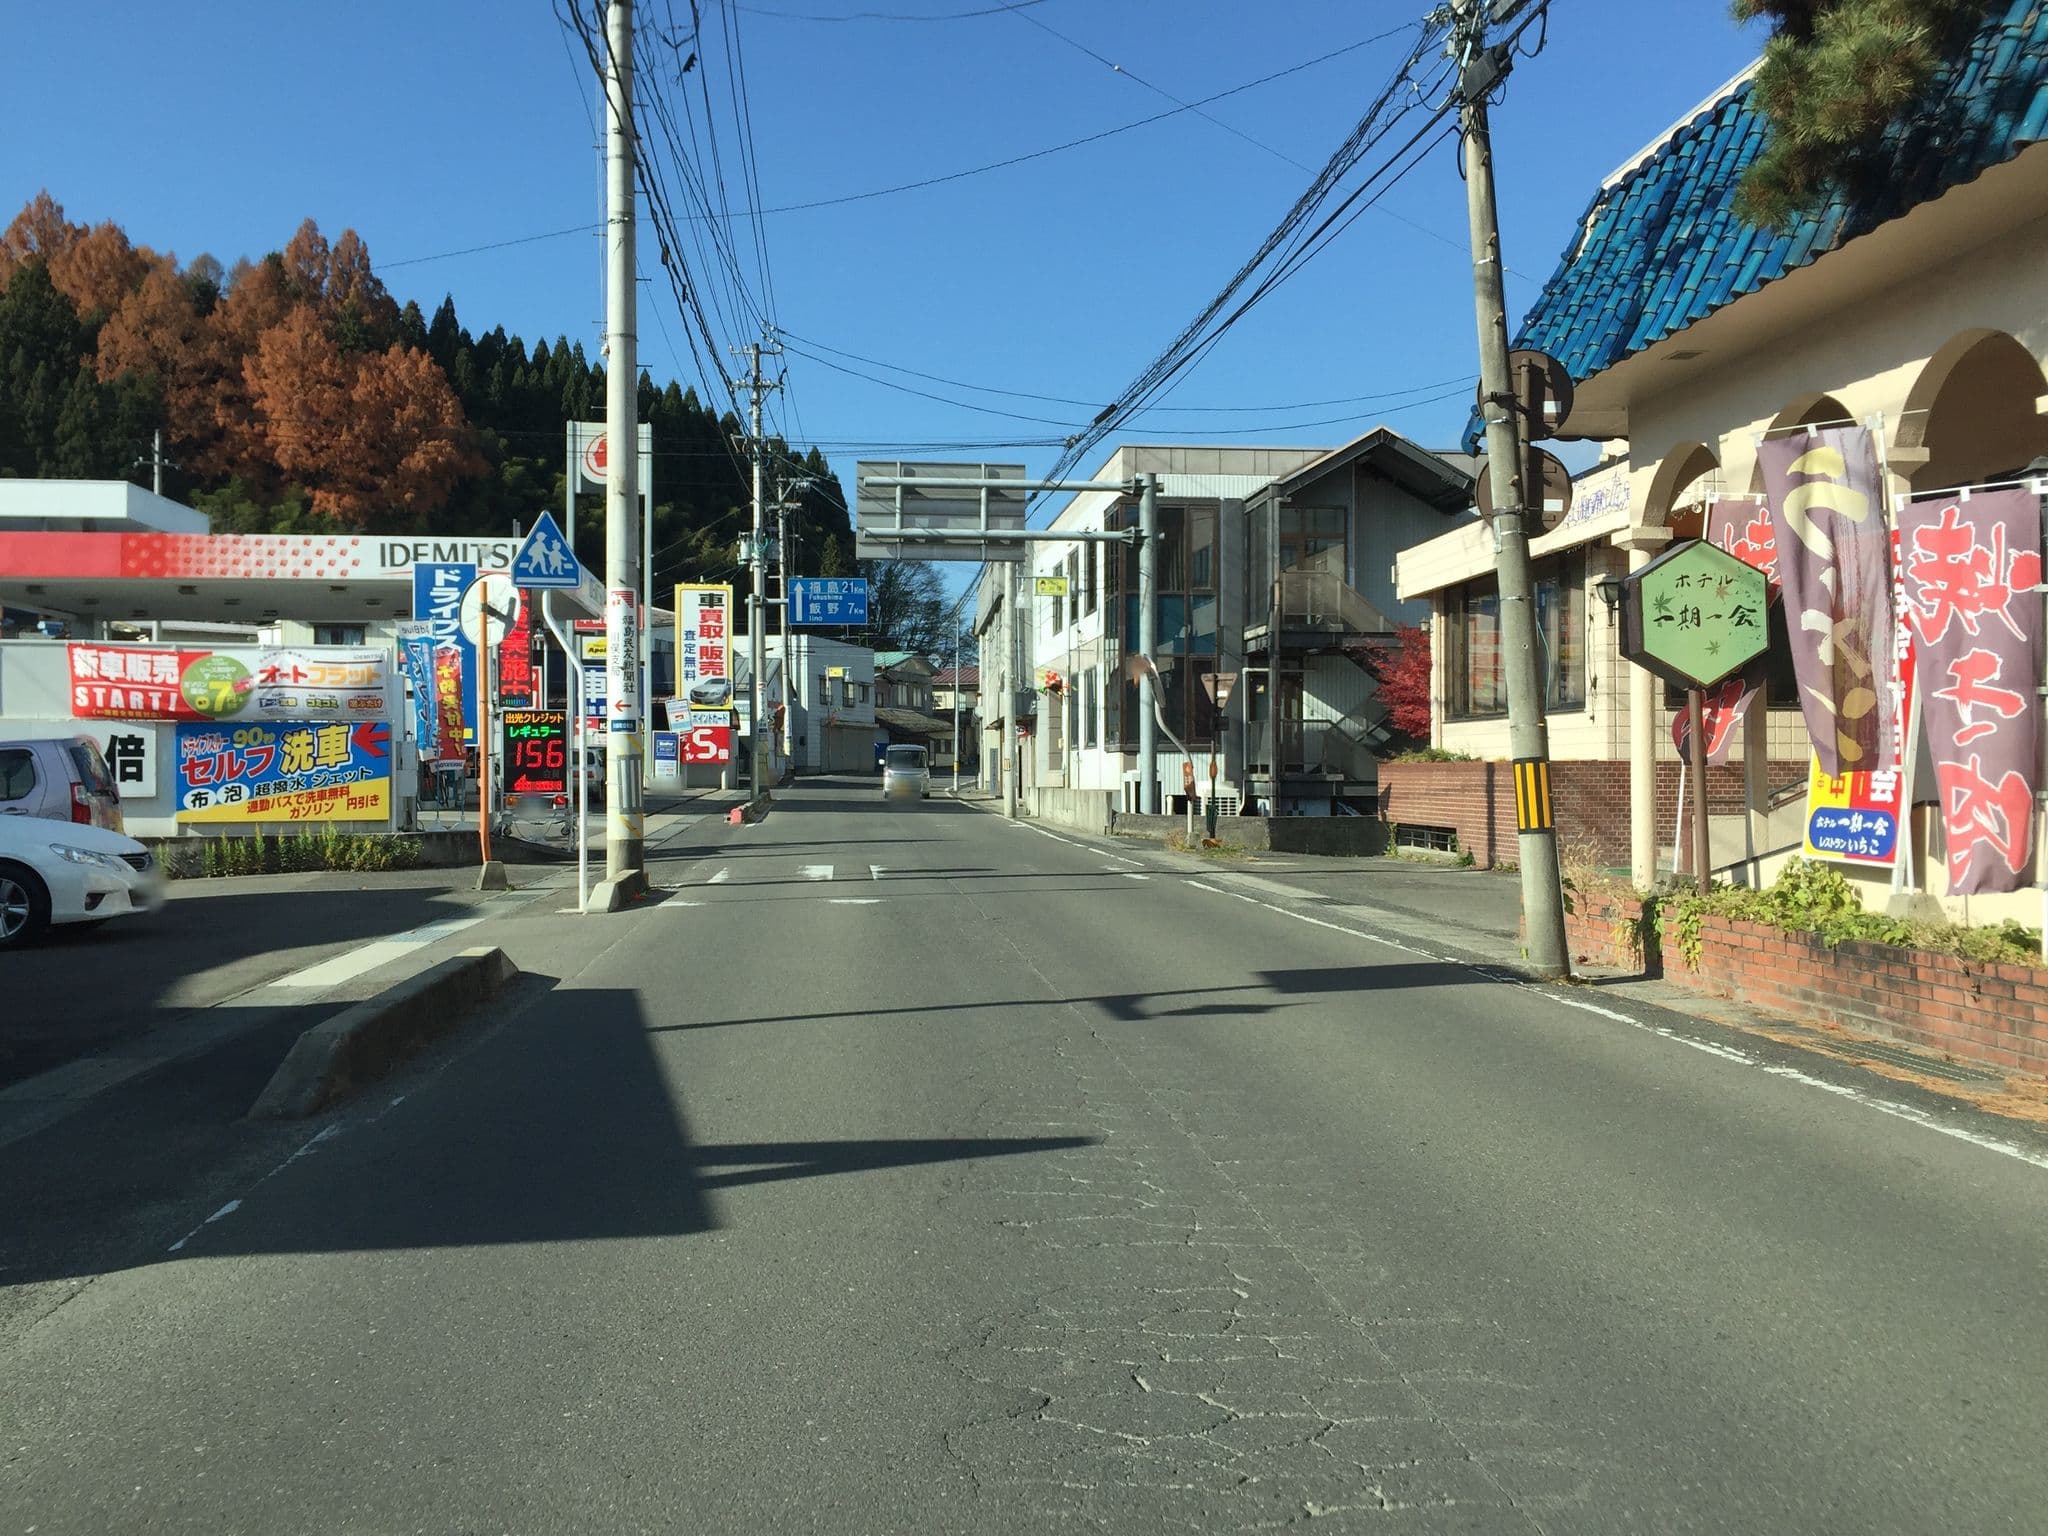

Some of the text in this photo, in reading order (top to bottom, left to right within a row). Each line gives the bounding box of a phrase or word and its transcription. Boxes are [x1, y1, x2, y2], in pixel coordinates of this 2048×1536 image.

[380, 543, 518, 568] IDEMITS
[810, 581, 838, 593] 福島
[1676, 574, 1733, 588] ホテル
[809, 603, 839, 614] 飯野
[1653, 604, 1757, 630] 一期一会
[72, 648, 179, 684] 新車販売
[622, 615, 635, 694] 福島民友新聞社
[684, 630, 697, 681] 査定無料
[259, 664, 381, 685] オートフラット
[75, 687, 178, 711] START!
[506, 713, 564, 724] 出光クレジット
[509, 725, 561, 737] レギュラー
[181, 724, 353, 786] セルフ 洗車
[515, 739, 563, 768] 156
[191, 791, 209, 809] 布
[223, 785, 243, 804] 泡
[312, 767, 373, 788] ジェット
[290, 794, 380, 820] ガソリン 円引き
[1816, 812, 1889, 836] ホテル 一期一会
[1819, 836, 1847, 850] レストラン
